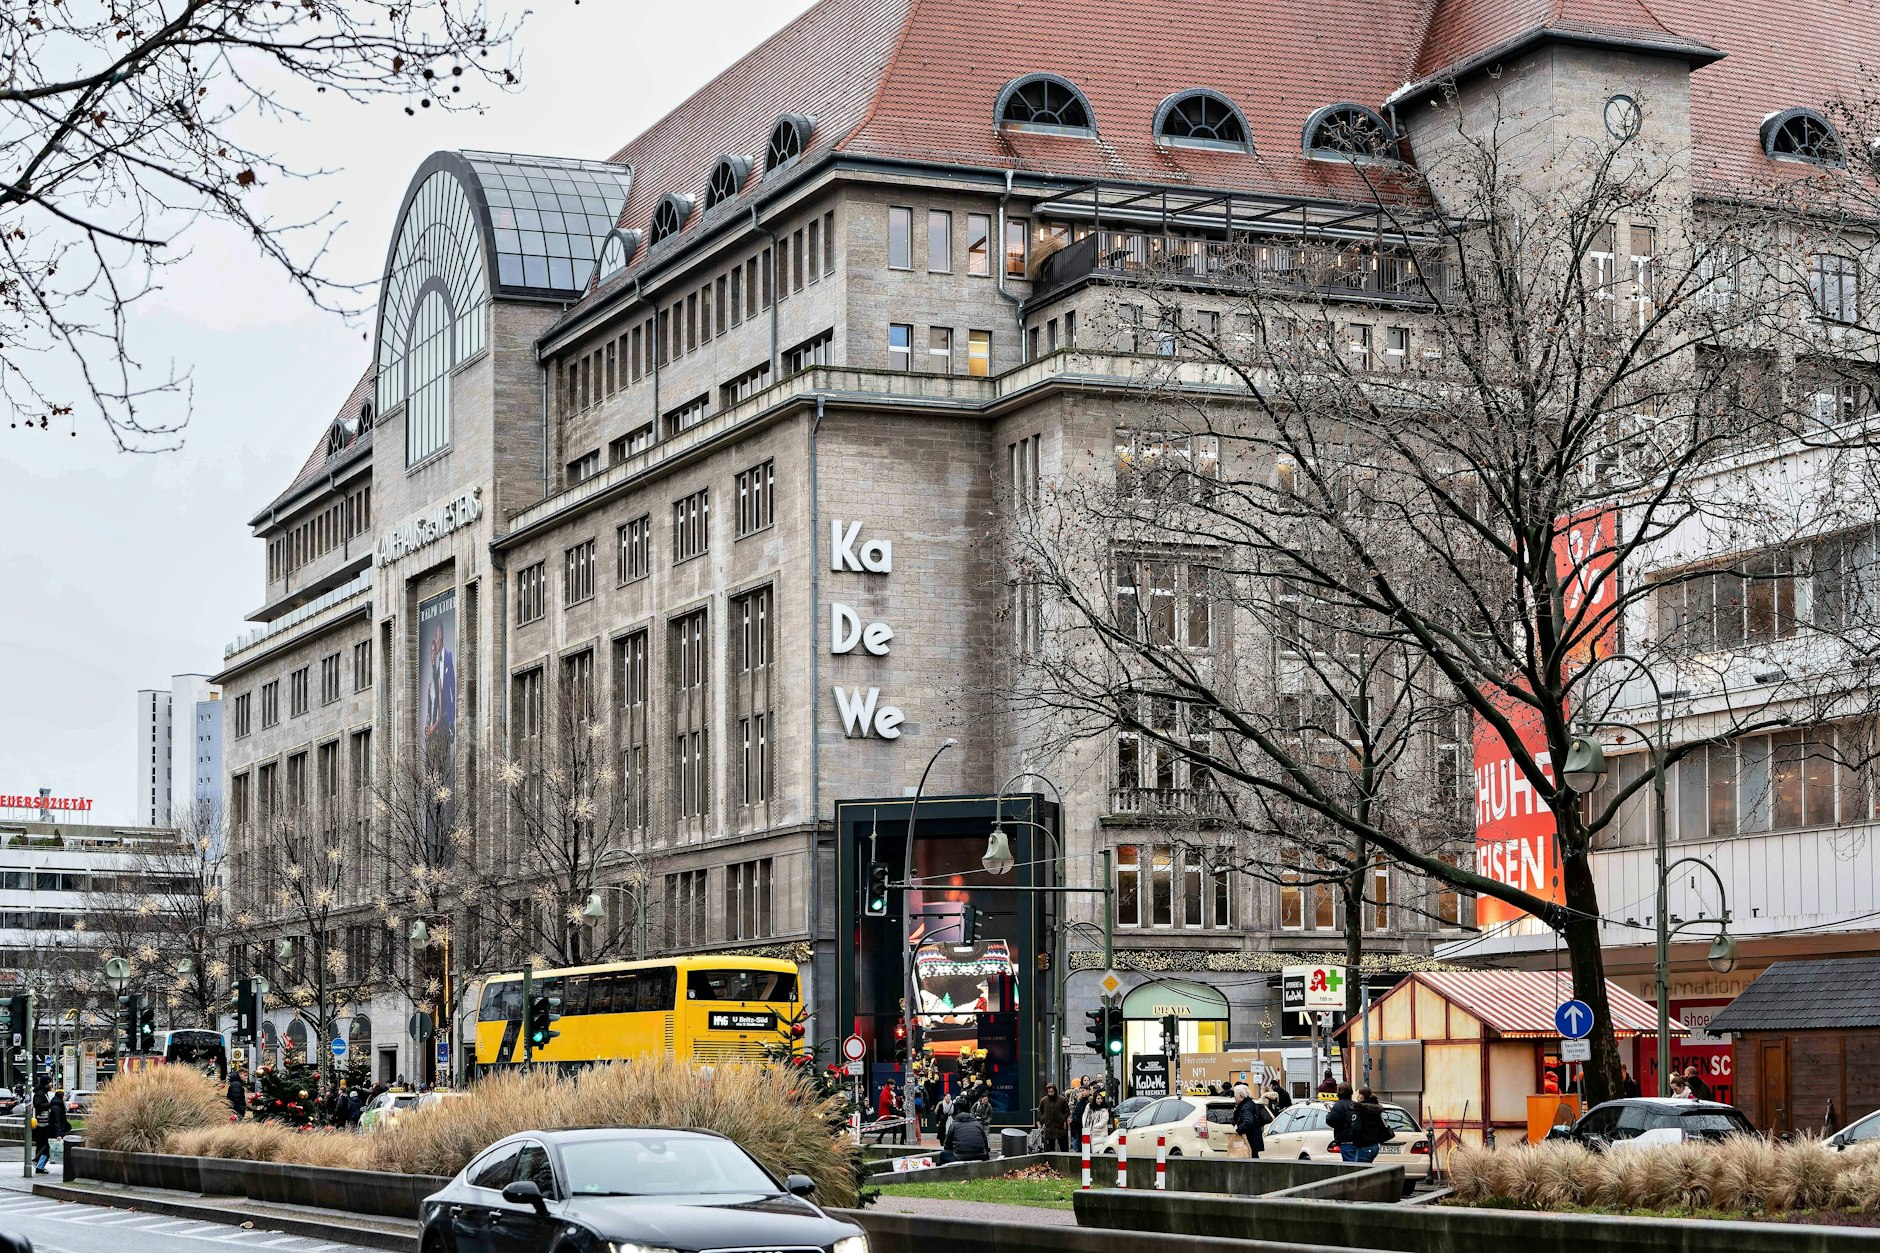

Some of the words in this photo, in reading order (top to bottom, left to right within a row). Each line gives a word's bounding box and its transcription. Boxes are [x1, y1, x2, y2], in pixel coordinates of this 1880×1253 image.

[434, 487, 483, 537] WESTENS
[831, 519, 892, 573] Ka
[831, 602, 894, 656] De
[832, 685, 906, 739] We
[0, 796, 93, 810] EUERSOZIETÄT
[1152, 1005, 1191, 1014] PRADA
[1136, 1075, 1166, 1089] KaDeWe
